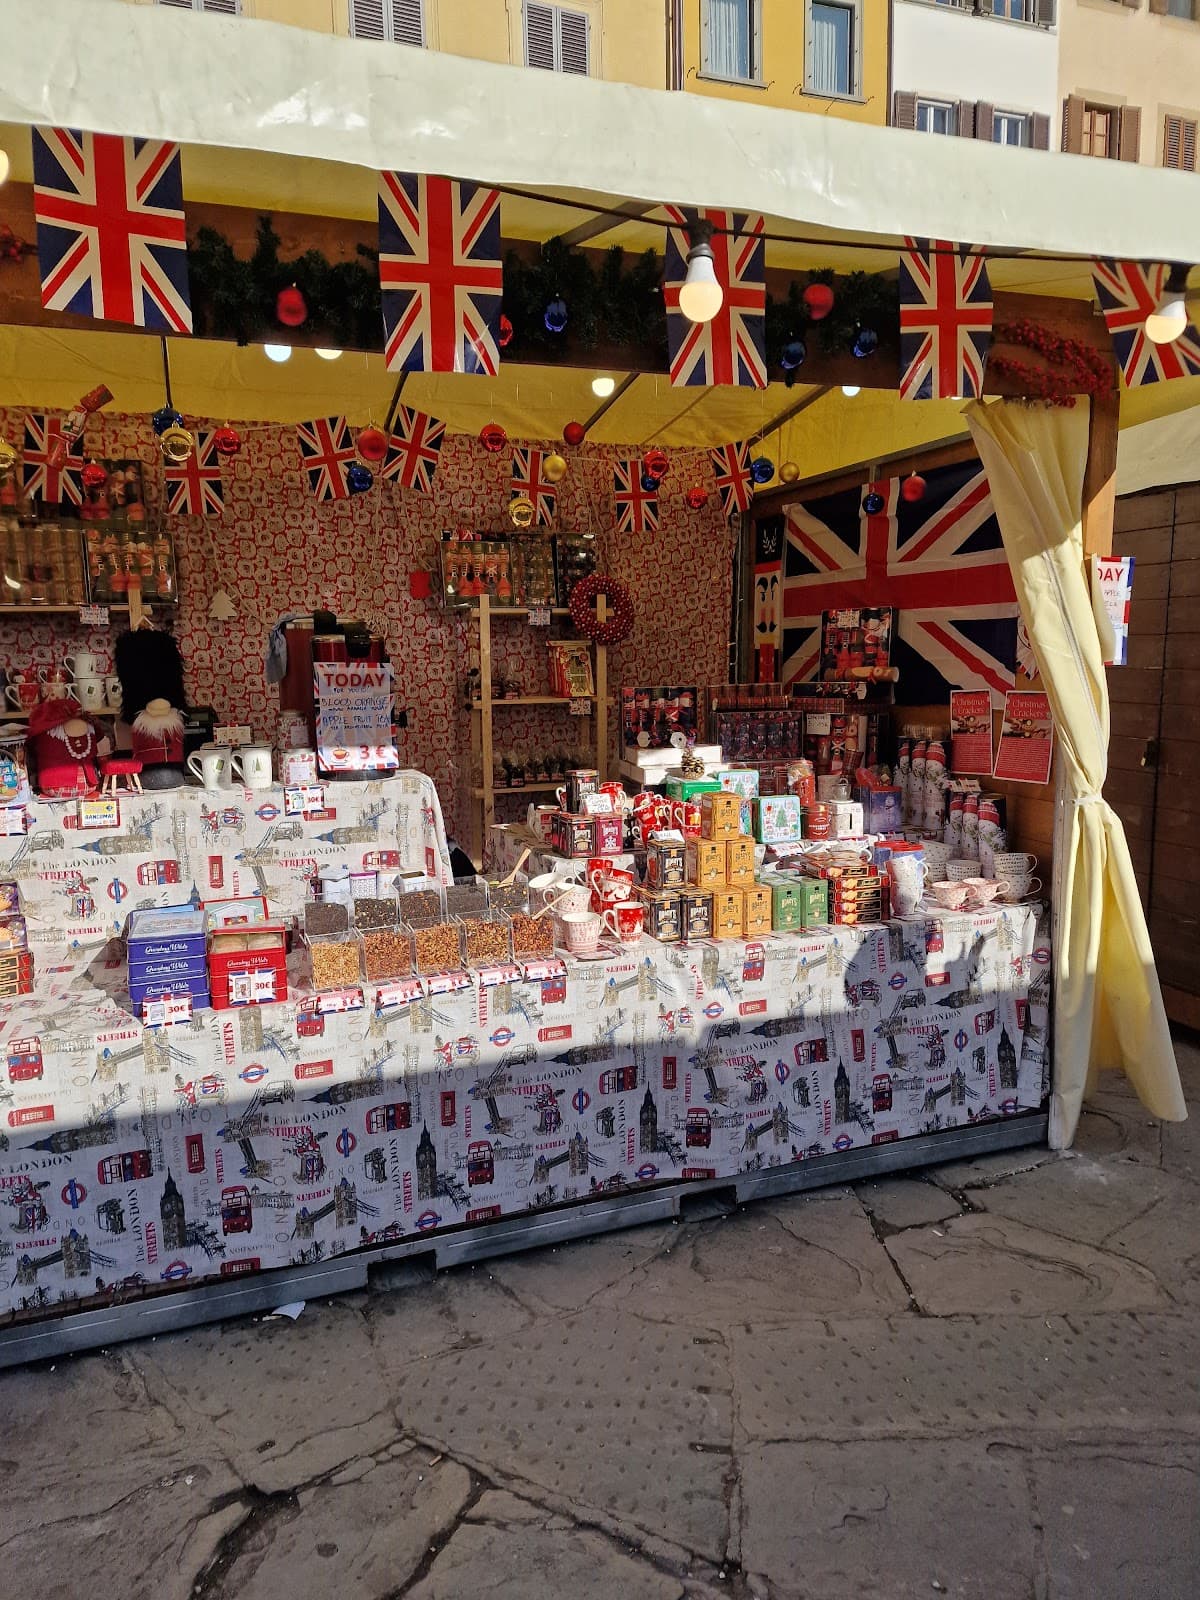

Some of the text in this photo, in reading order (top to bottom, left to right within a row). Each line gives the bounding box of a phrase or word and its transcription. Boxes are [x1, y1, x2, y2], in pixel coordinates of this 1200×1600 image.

[324, 673, 385, 687] TODAY
[1012, 699, 1046, 709] Christmas
[353, 715, 372, 724] FRUIT
[359, 744, 387, 760] 3 €
[302, 845, 347, 856] LONDON
[42, 857, 118, 870] The LONDON
[278, 858, 317, 868] STREETS
[37, 870, 83, 881] STREETS
[67, 926, 103, 936] STREETS
[877, 937, 887, 973] STREETS
[254, 982, 271, 991] 30€
[168, 1004, 186, 1014] 30€
[478, 985, 488, 1028] STREETS
[926, 1010, 962, 1022] LONDON
[96, 1029, 138, 1043] STREETS
[907, 1024, 939, 1036] STREETS
[222, 1021, 236, 1065] STREETS
[739, 1039, 779, 1055] LONDON
[724, 1054, 754, 1067] STREETS
[537, 1067, 583, 1082] LONDON
[988, 1063, 997, 1098] STREETS
[512, 1082, 552, 1096] STREETS
[684, 1073, 692, 1104] STREETS
[294, 1104, 347, 1122] LONDON
[823, 1099, 832, 1137] STREETS
[464, 1103, 473, 1139] STREETS
[617, 1099, 627, 1146] LONDON
[269, 1125, 313, 1138] STREETS
[627, 1127, 636, 1166] STREETS
[9, 1153, 73, 1174] LONDON
[215, 1148, 225, 1185] STREETS
[389, 1138, 401, 1192] LONDON
[296, 1187, 332, 1202] STREETS
[402, 1171, 413, 1214] STREETS
[127, 1187, 144, 1242] LONDON
[15, 1236, 57, 1250] STREETS
[145, 1221, 159, 1265] STREETS
